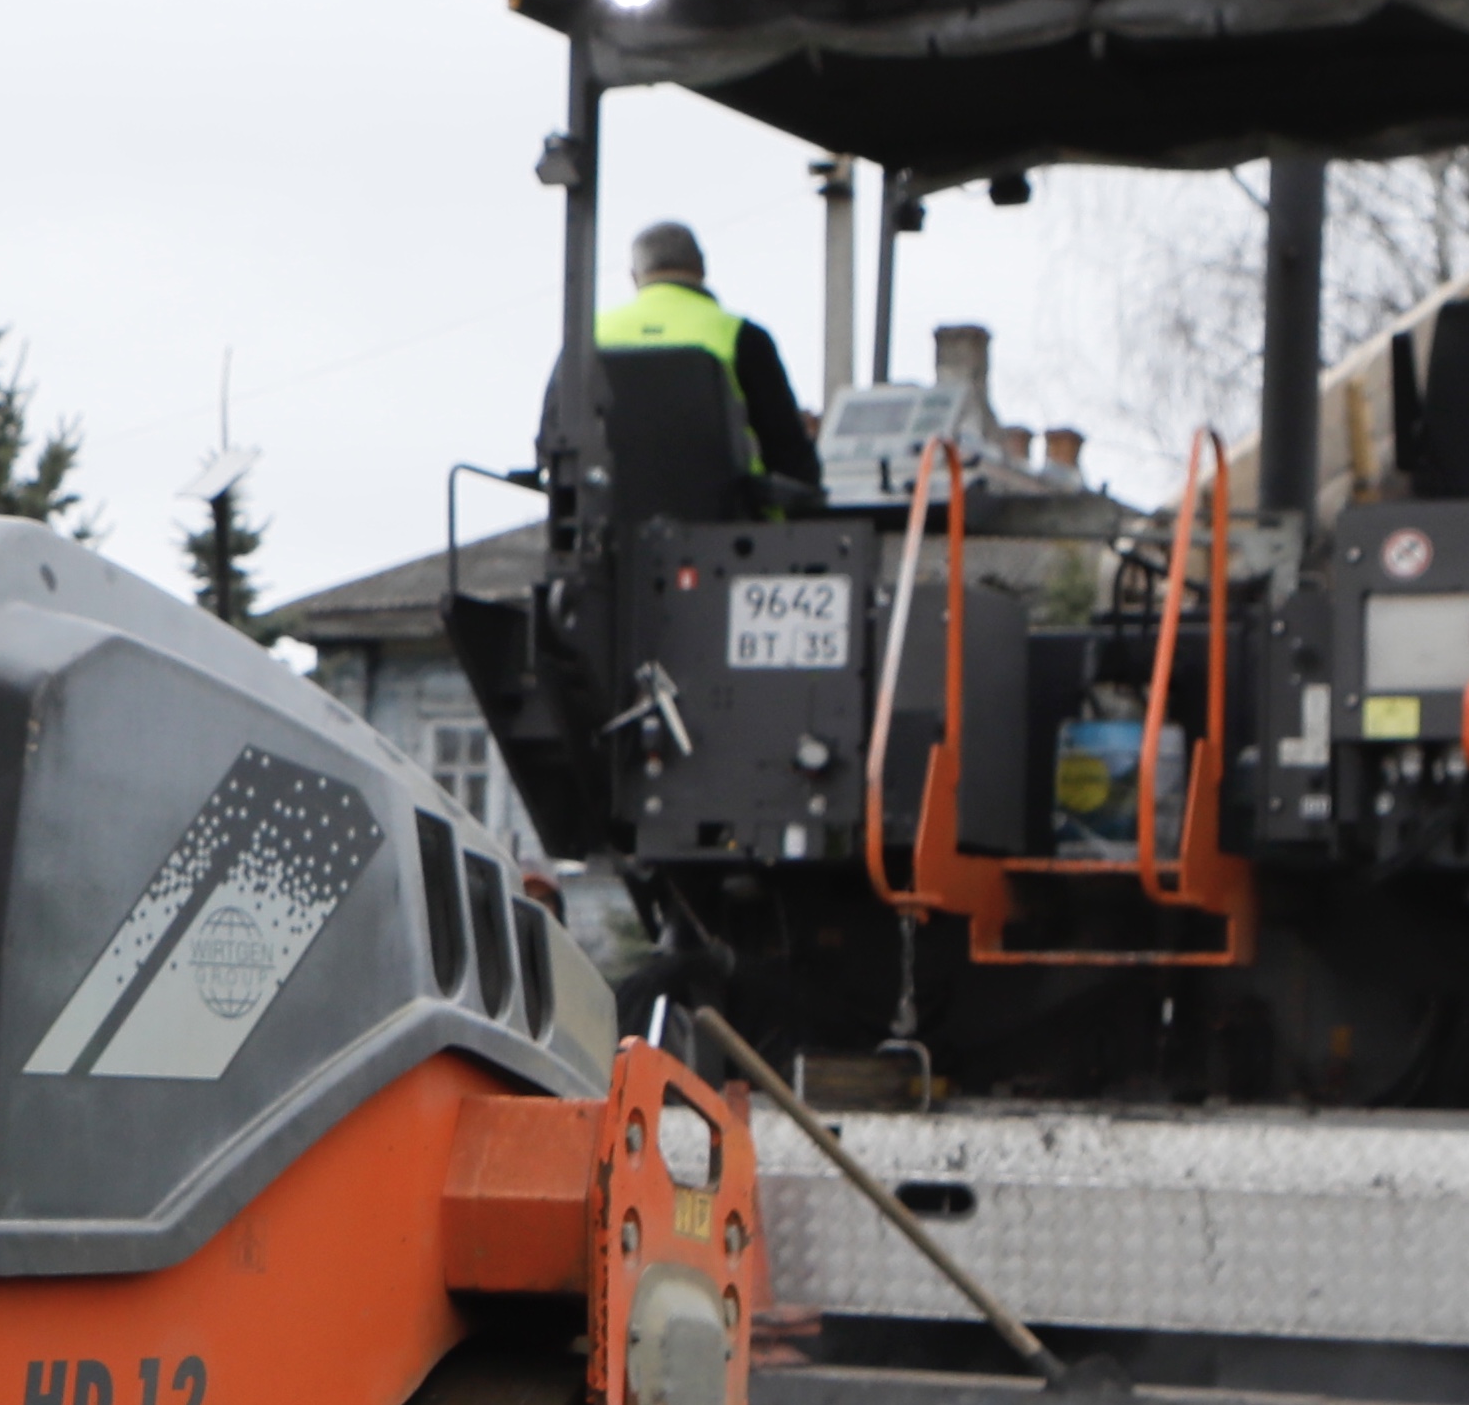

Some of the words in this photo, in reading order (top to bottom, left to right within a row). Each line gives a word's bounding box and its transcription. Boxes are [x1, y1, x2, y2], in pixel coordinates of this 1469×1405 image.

[745, 583, 835, 619] 9642
[739, 631, 779, 660] ВТ
[805, 632, 839, 660] 35
[189, 938, 274, 965] WIRTGEN
